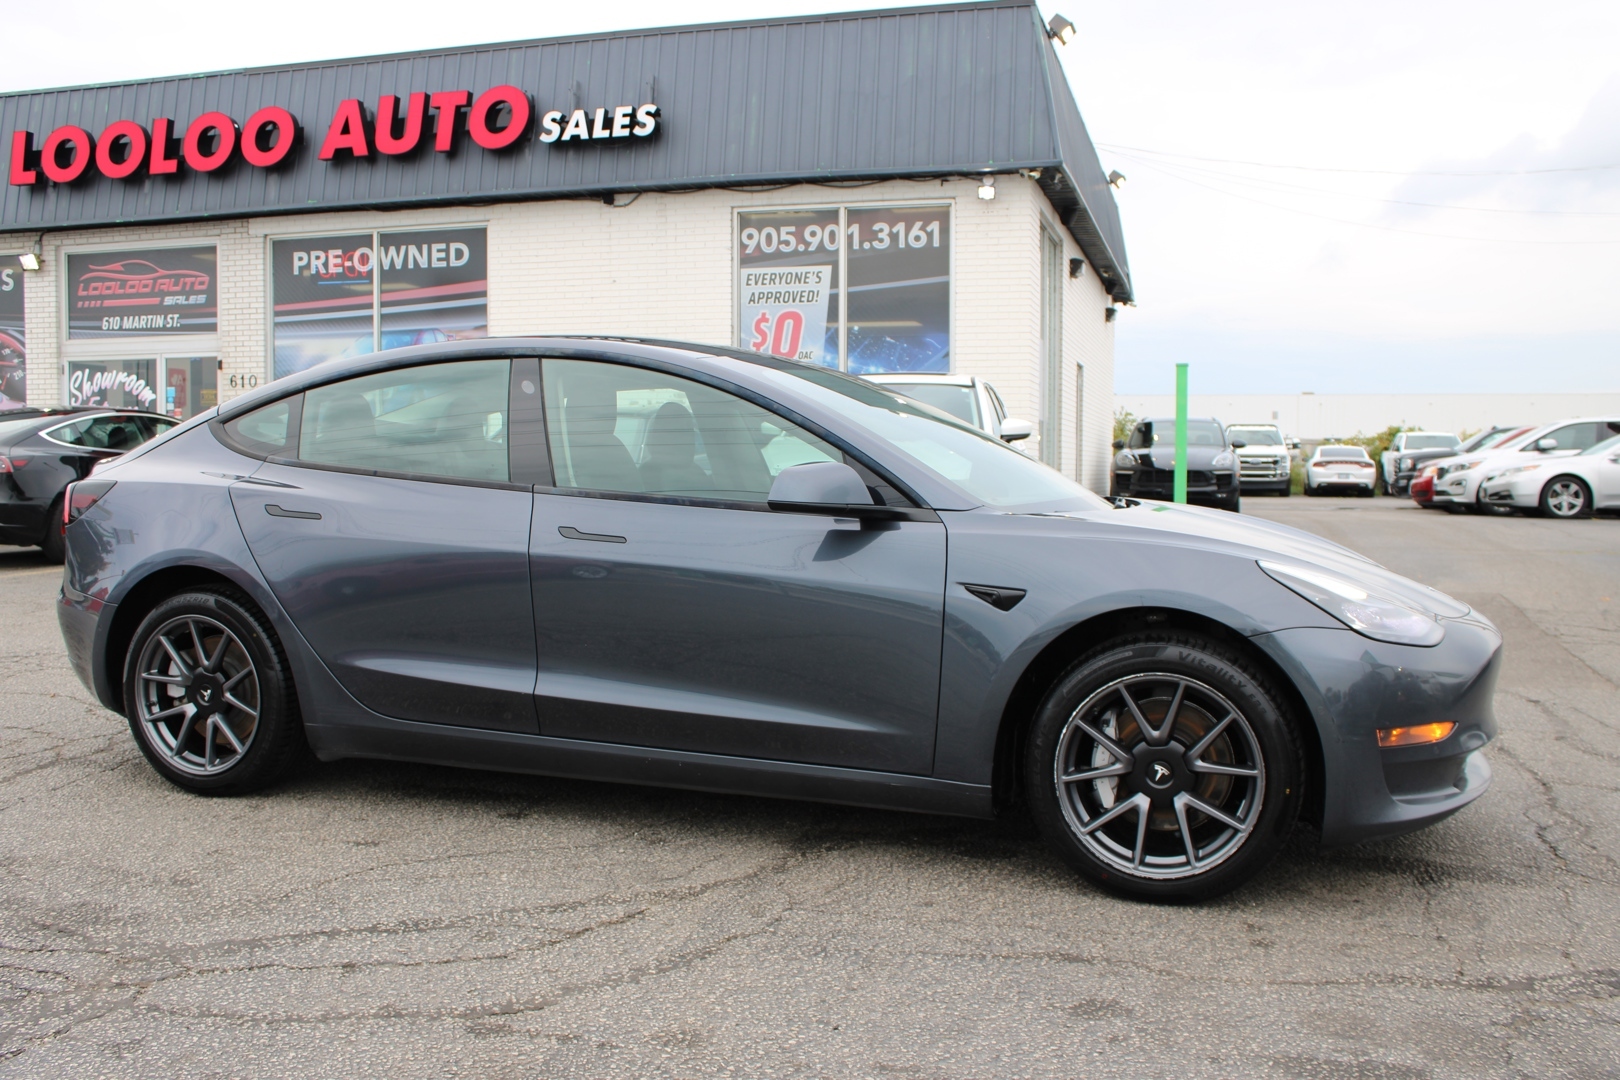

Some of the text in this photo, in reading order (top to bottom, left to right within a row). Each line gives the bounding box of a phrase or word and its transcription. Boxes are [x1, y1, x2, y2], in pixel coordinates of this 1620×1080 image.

[10, 84, 659, 187] LOOLOO AUTO SALES
[741, 220, 940, 254] 905.901.3161
[292, 242, 470, 276] PRE-OWNED
[77, 276, 210, 297] LOOLOO AUTO
[745, 270, 823, 287] EVERYONE'S
[163, 294, 207, 306] SALES
[747, 289, 820, 305] APPROVED!
[102, 313, 181, 331] 610 MARTIN ST.
[751, 310, 804, 360] $0
[797, 350, 814, 360] OAC
[69, 368, 157, 407] Showroom
[229, 374, 258, 389] 610
